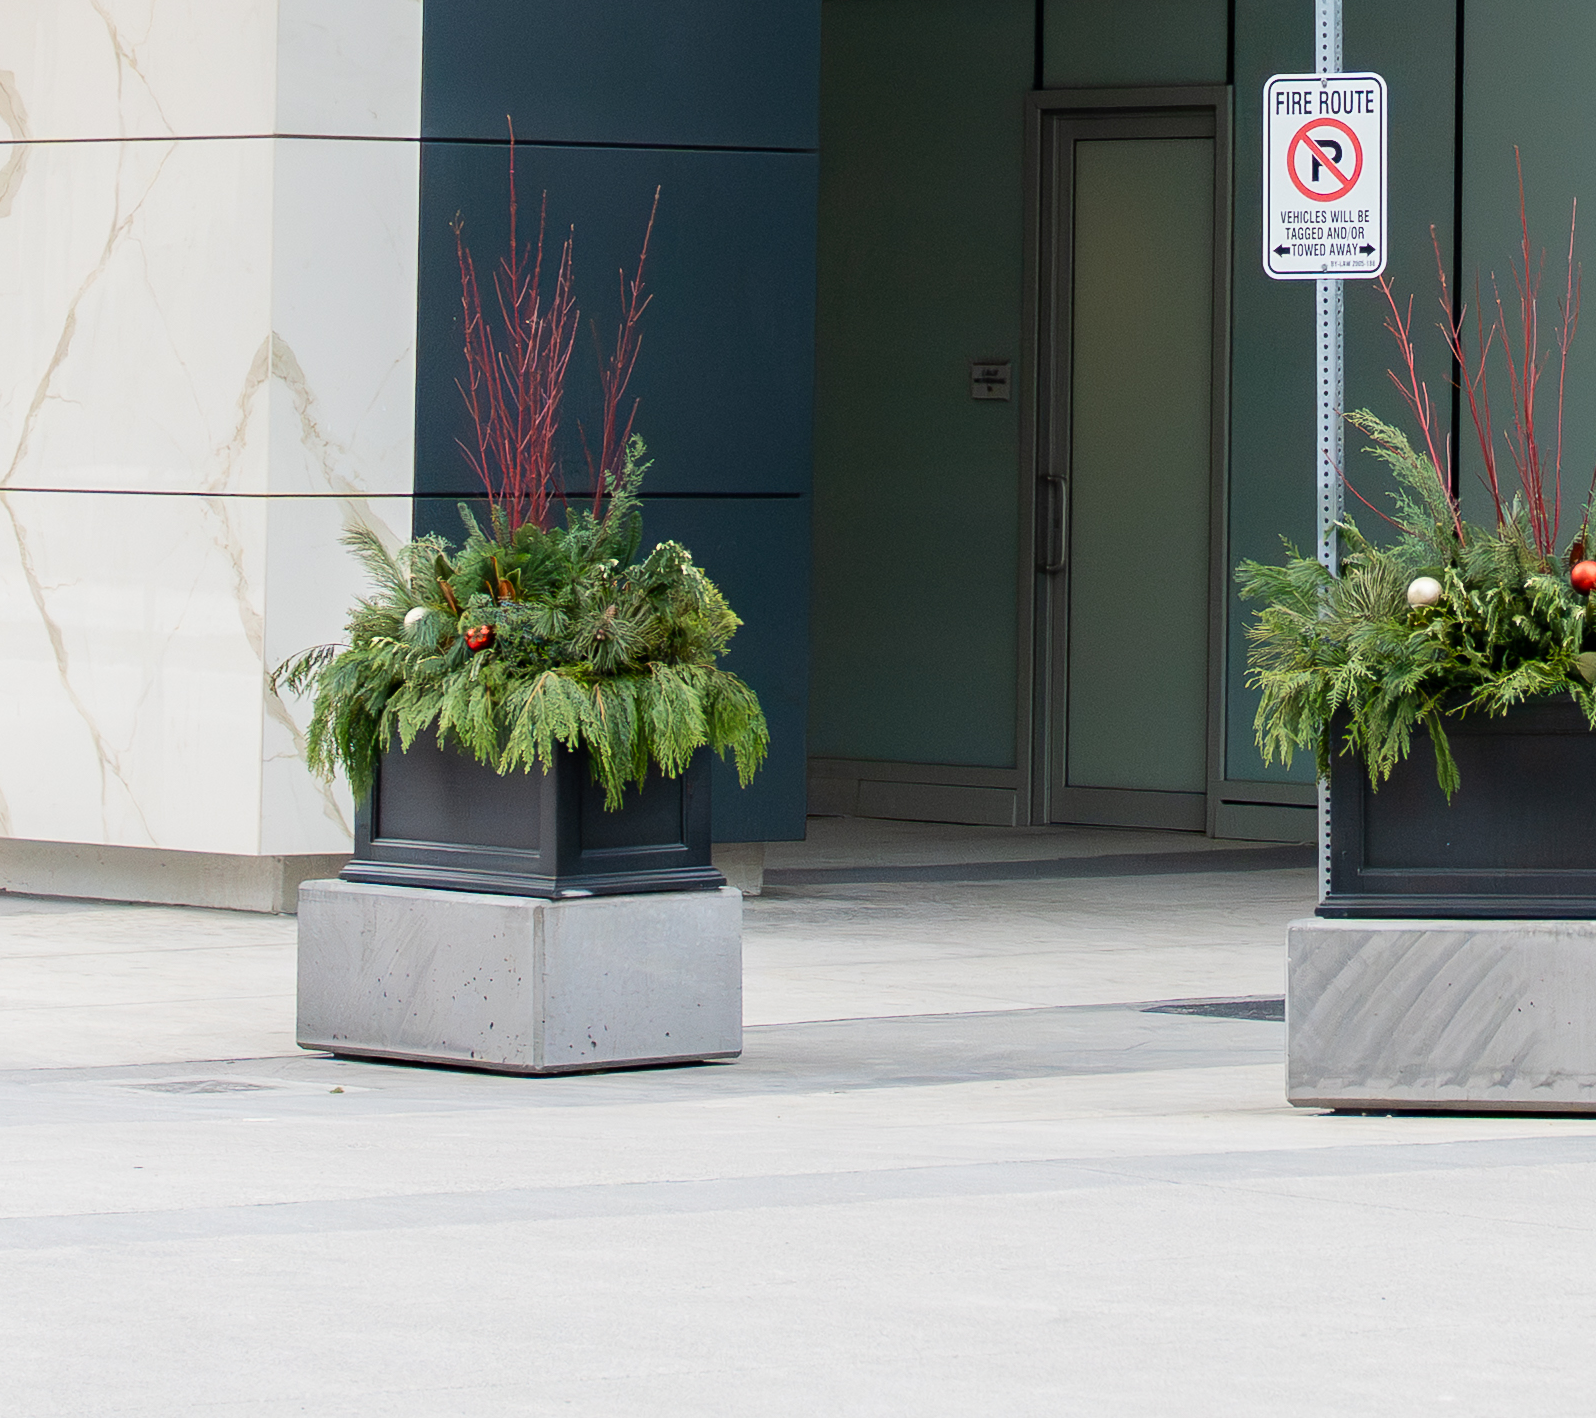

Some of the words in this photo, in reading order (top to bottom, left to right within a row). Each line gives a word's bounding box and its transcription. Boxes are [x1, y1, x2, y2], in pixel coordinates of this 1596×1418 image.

[1275, 91, 1313, 115] FIRE
[1318, 90, 1375, 114] ROUTE
[1280, 210, 1327, 224] VEHICLES
[1330, 210, 1355, 223] WILL
[1357, 209, 1370, 223] BE
[1285, 227, 1324, 240] TAGGED
[1326, 226, 1365, 240] AND/OR
[1291, 243, 1326, 257] TOWED
[1329, 243, 1359, 256] AWAY
